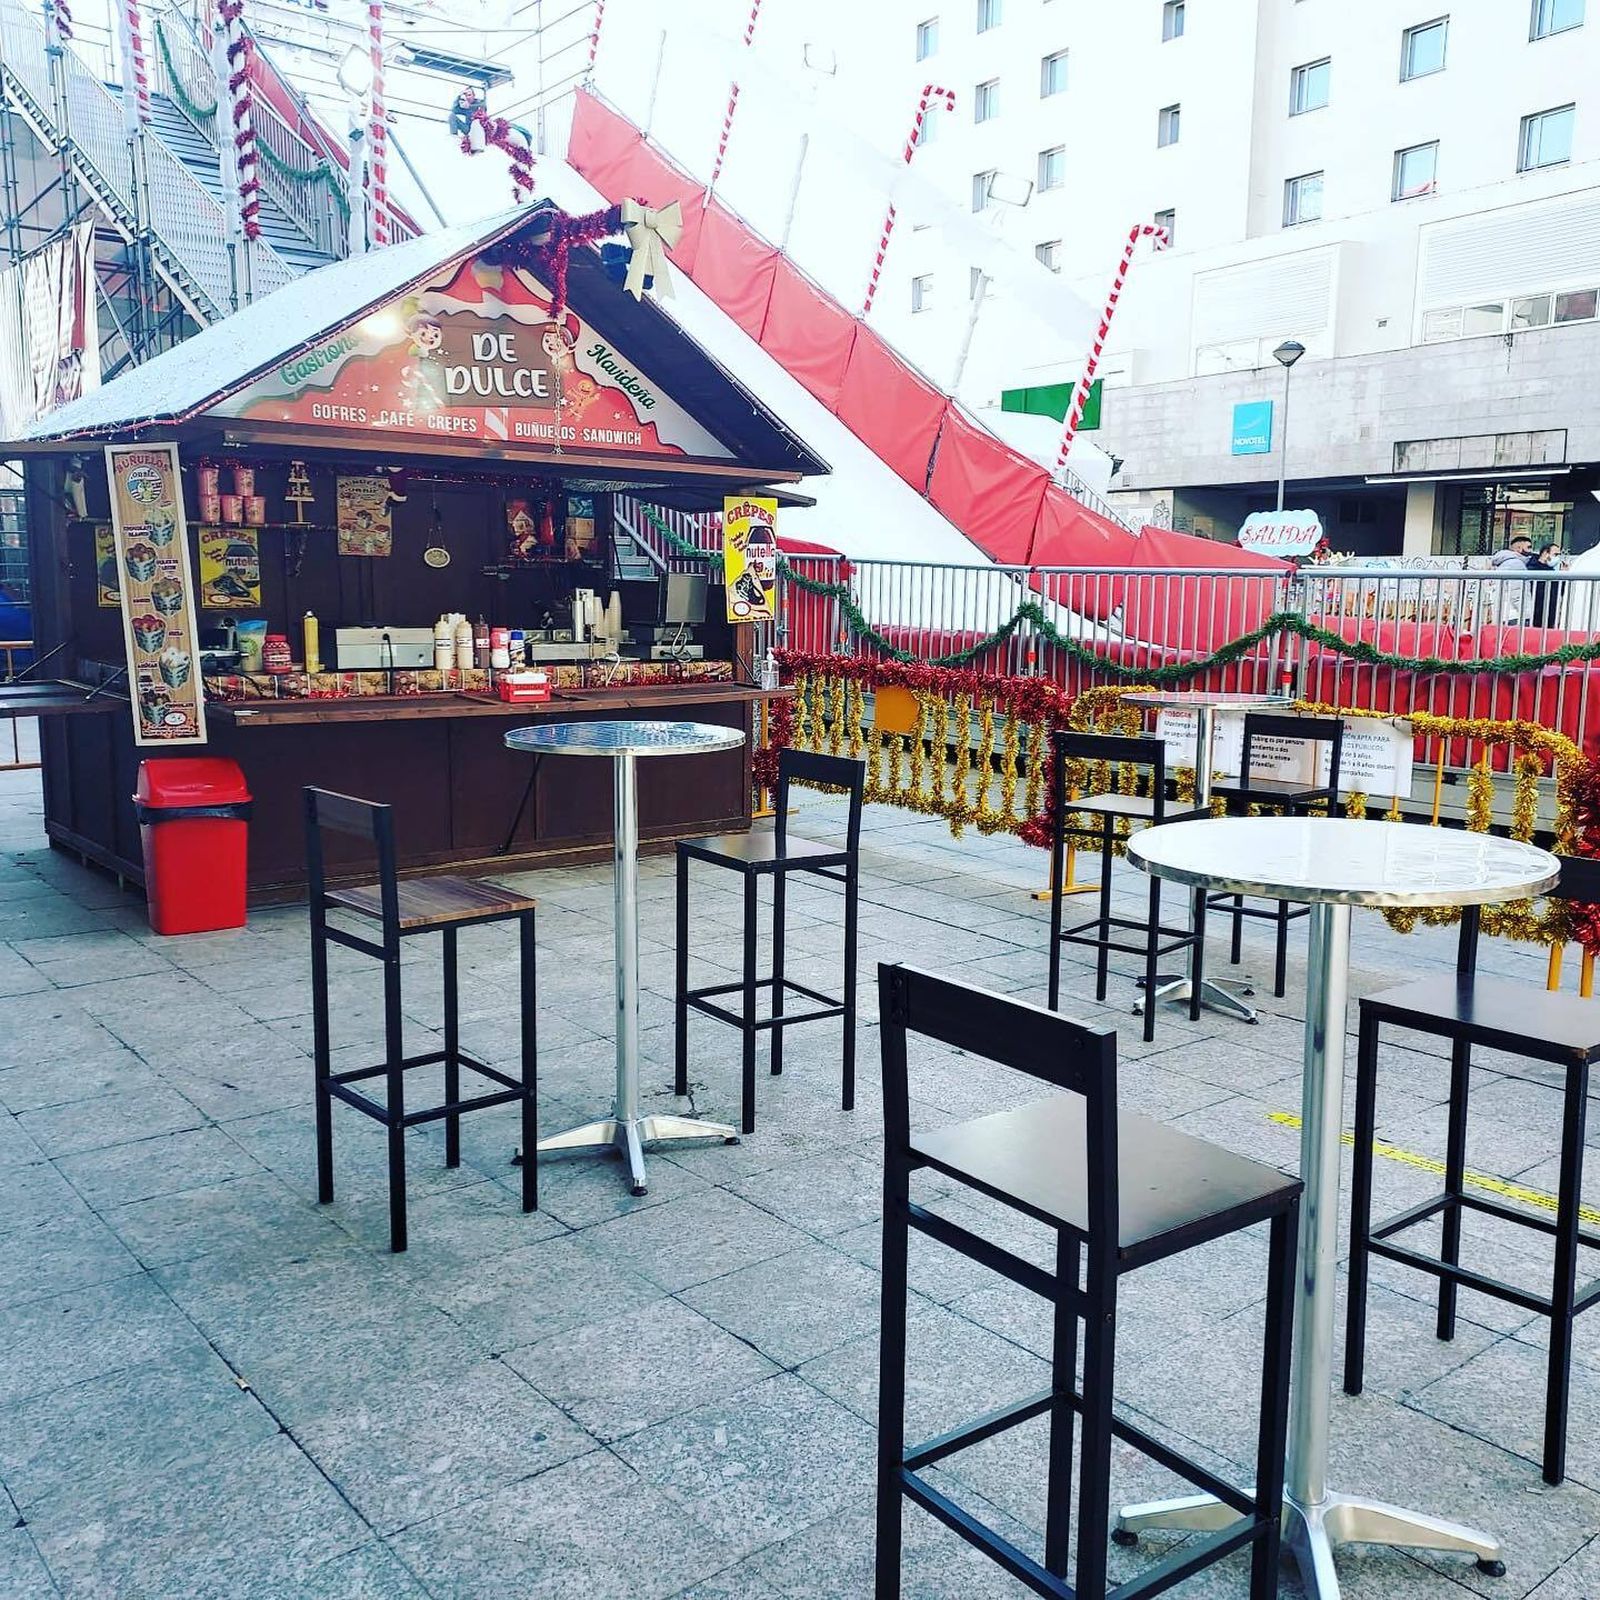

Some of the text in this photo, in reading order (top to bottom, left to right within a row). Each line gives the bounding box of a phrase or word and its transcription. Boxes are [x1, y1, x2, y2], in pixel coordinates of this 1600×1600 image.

[472, 332, 518, 363] DE
[445, 366, 550, 398] DULCE
[586, 343, 656, 411] Navideña
[312, 403, 367, 422] GOFRES
[380, 409, 415, 427] CAFÉ
[428, 414, 477, 434] CREPES
[583, 427, 643, 447] SANDWICH
[1235, 436, 1266, 446] NOVOTEL
[727, 502, 774, 525] CRÊPES
[1242, 524, 1317, 544] SALIDA
